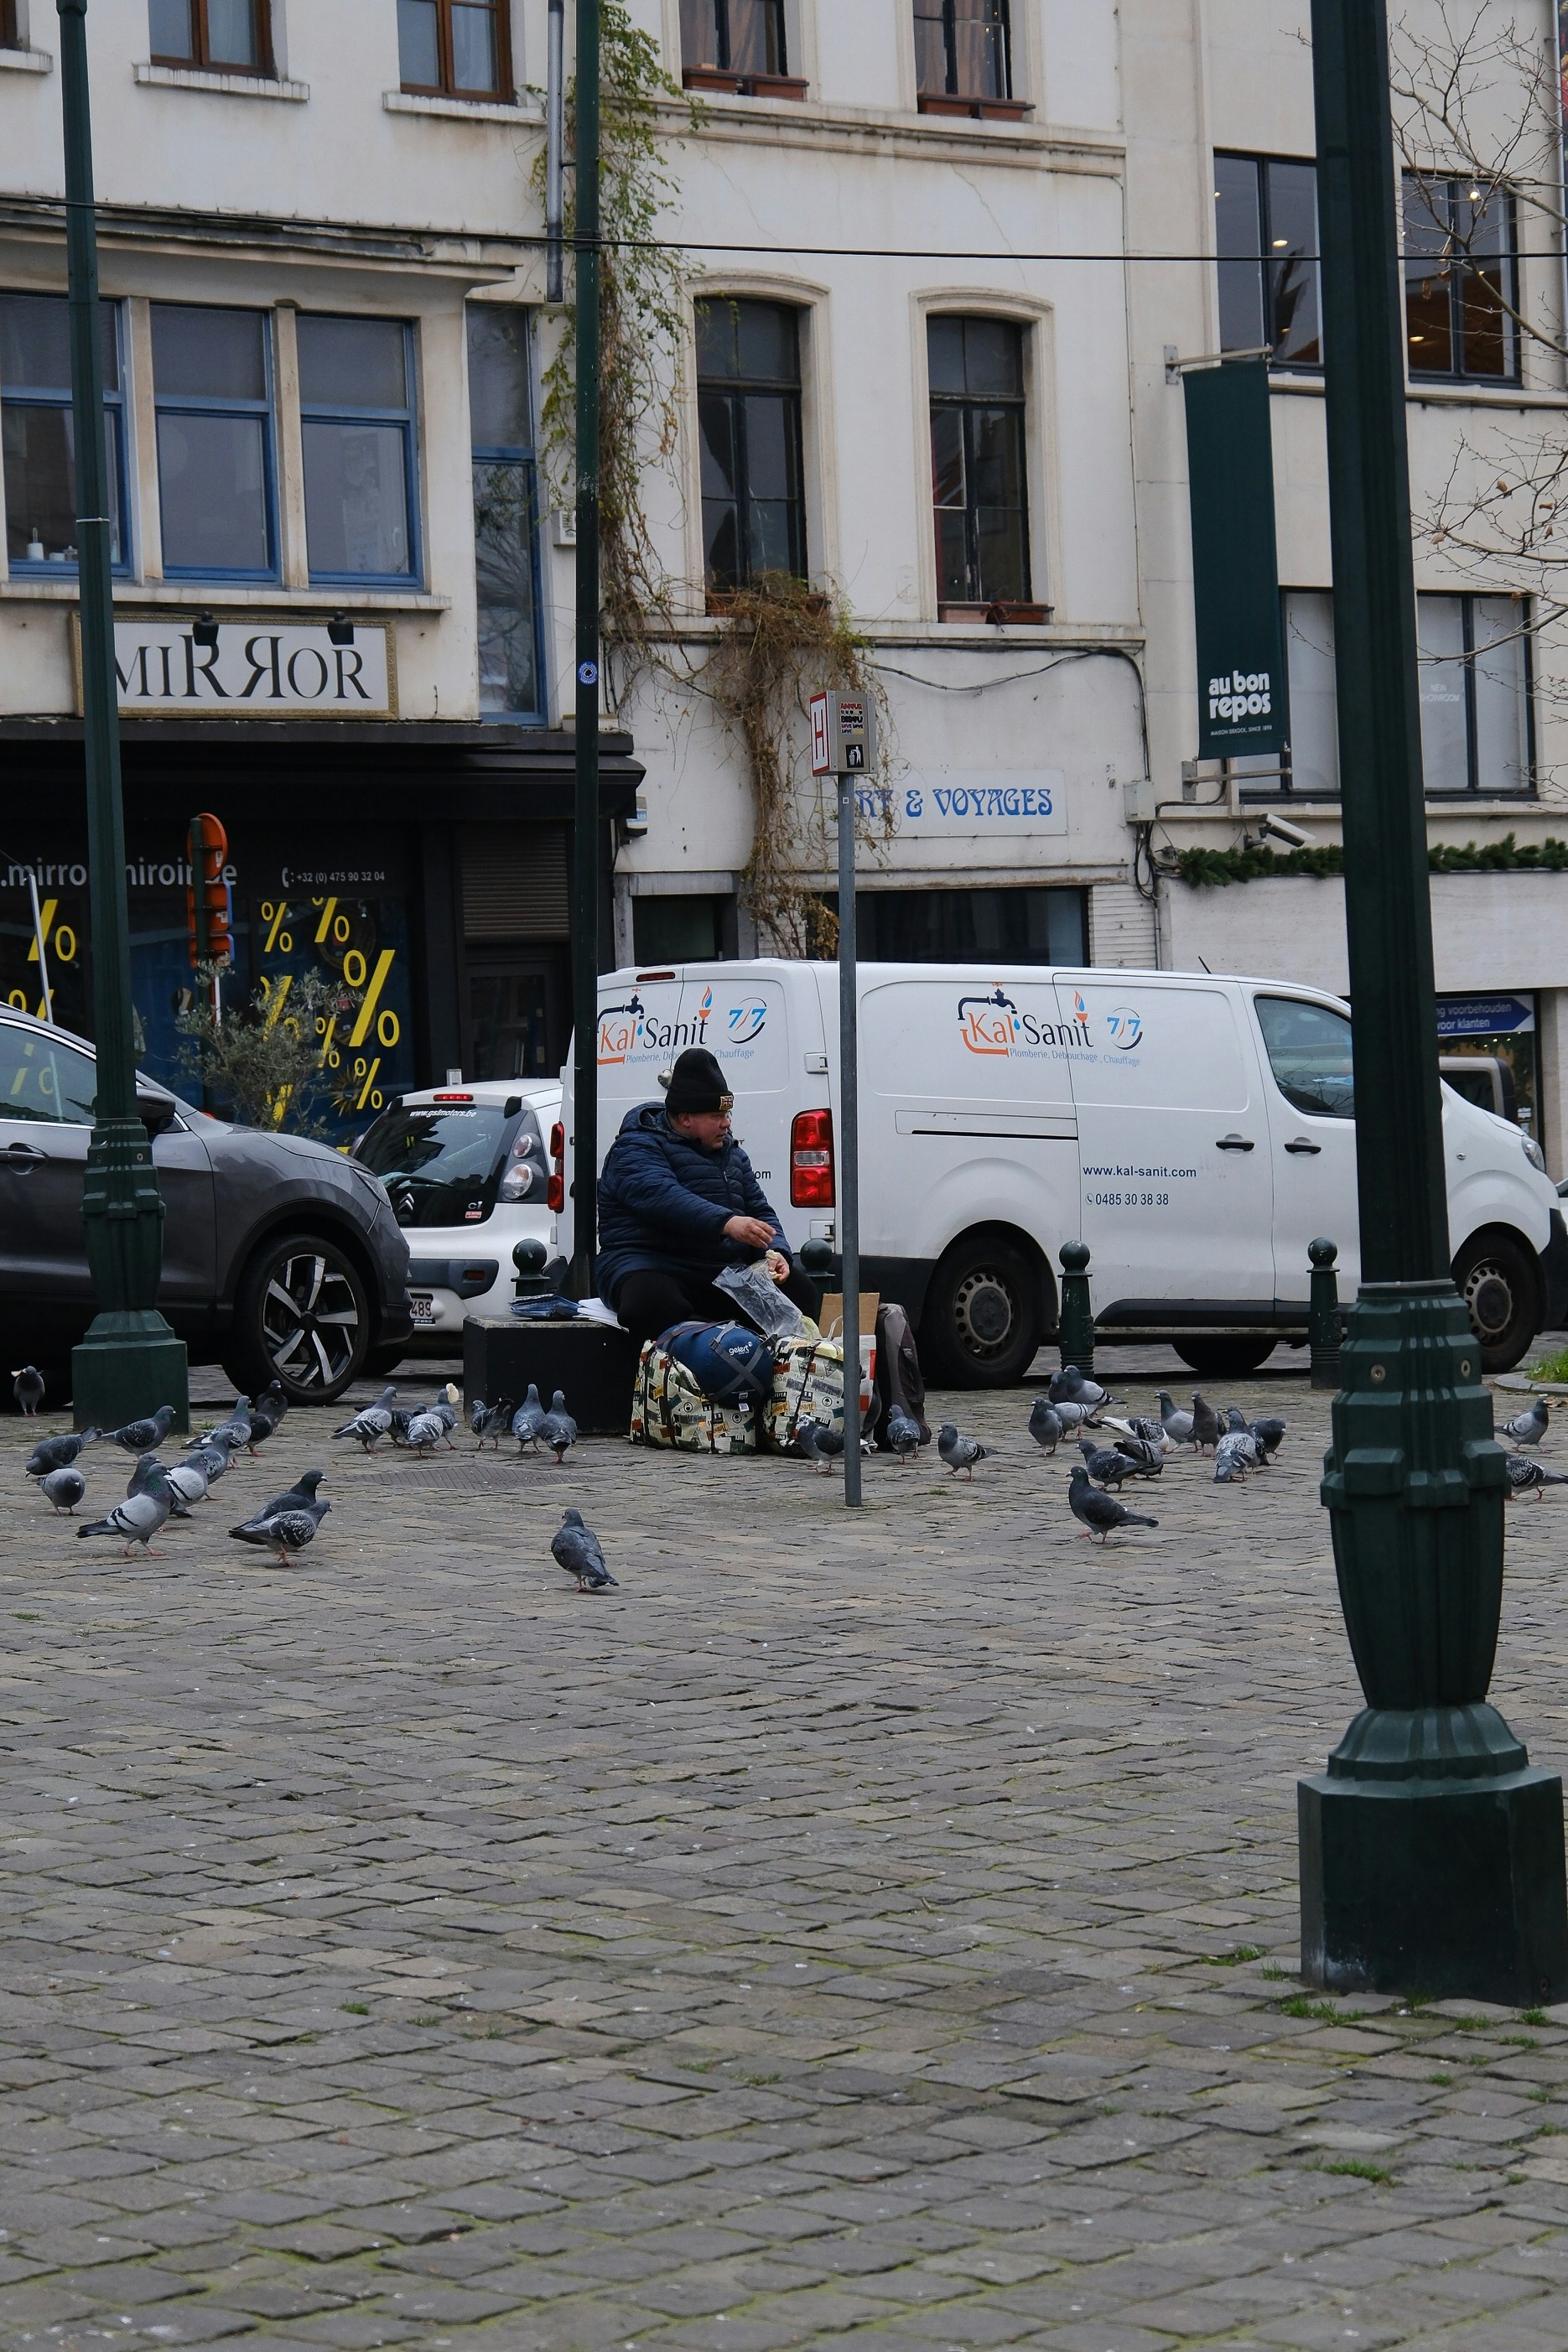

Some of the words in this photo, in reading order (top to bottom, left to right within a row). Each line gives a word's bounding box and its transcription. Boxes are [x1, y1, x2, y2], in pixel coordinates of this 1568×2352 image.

[1209, 677, 1231, 695] au
[1233, 670, 1270, 693] bon
[1209, 693, 1271, 723] repos
[906, 790, 923, 817] &
[932, 787, 1053, 816] VOYAGES
[297, 872, 314, 882] +32
[315, 872, 327, 884] (0)
[330, 872, 346, 881] 475
[348, 872, 359, 881] 90
[361, 872, 371, 881] 32
[374, 871, 385, 880] 04
[1448, 1003, 1512, 1015] voorbehouden
[1457, 1018, 1490, 1029] klanten
[714, 1049, 755, 1060] Chauffage
[1103, 1054, 1141, 1067] Chauffage
[1083, 1165, 1197, 1177] www.kal-sanit.com
[1095, 1193, 1122, 1205] 0485
[1124, 1193, 1138, 1205] 30
[1140, 1193, 1154, 1205] 38
[1156, 1193, 1170, 1205] 38
[729, 1344, 749, 1356] gelert
